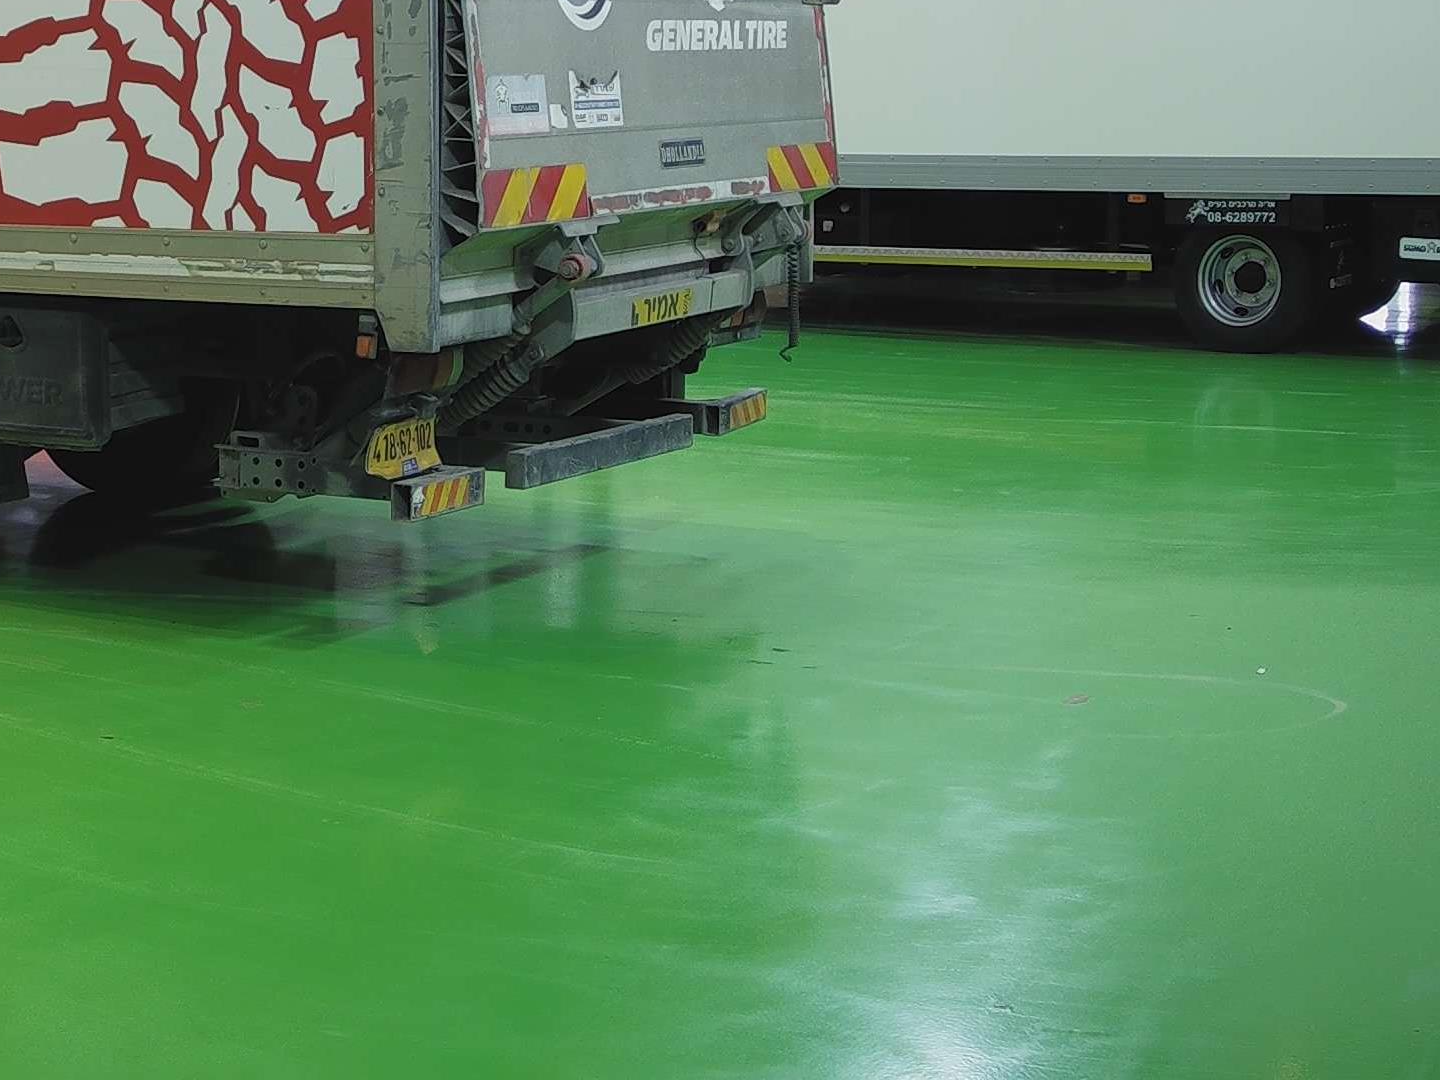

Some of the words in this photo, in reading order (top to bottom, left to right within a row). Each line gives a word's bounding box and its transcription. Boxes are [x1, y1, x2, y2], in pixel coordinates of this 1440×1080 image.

[646, 19, 744, 52] GENERAL
[745, 19, 788, 50] TIRE
[660, 143, 705, 162] DHOLLANDIA
[1207, 211, 1276, 223] 08-6289772
